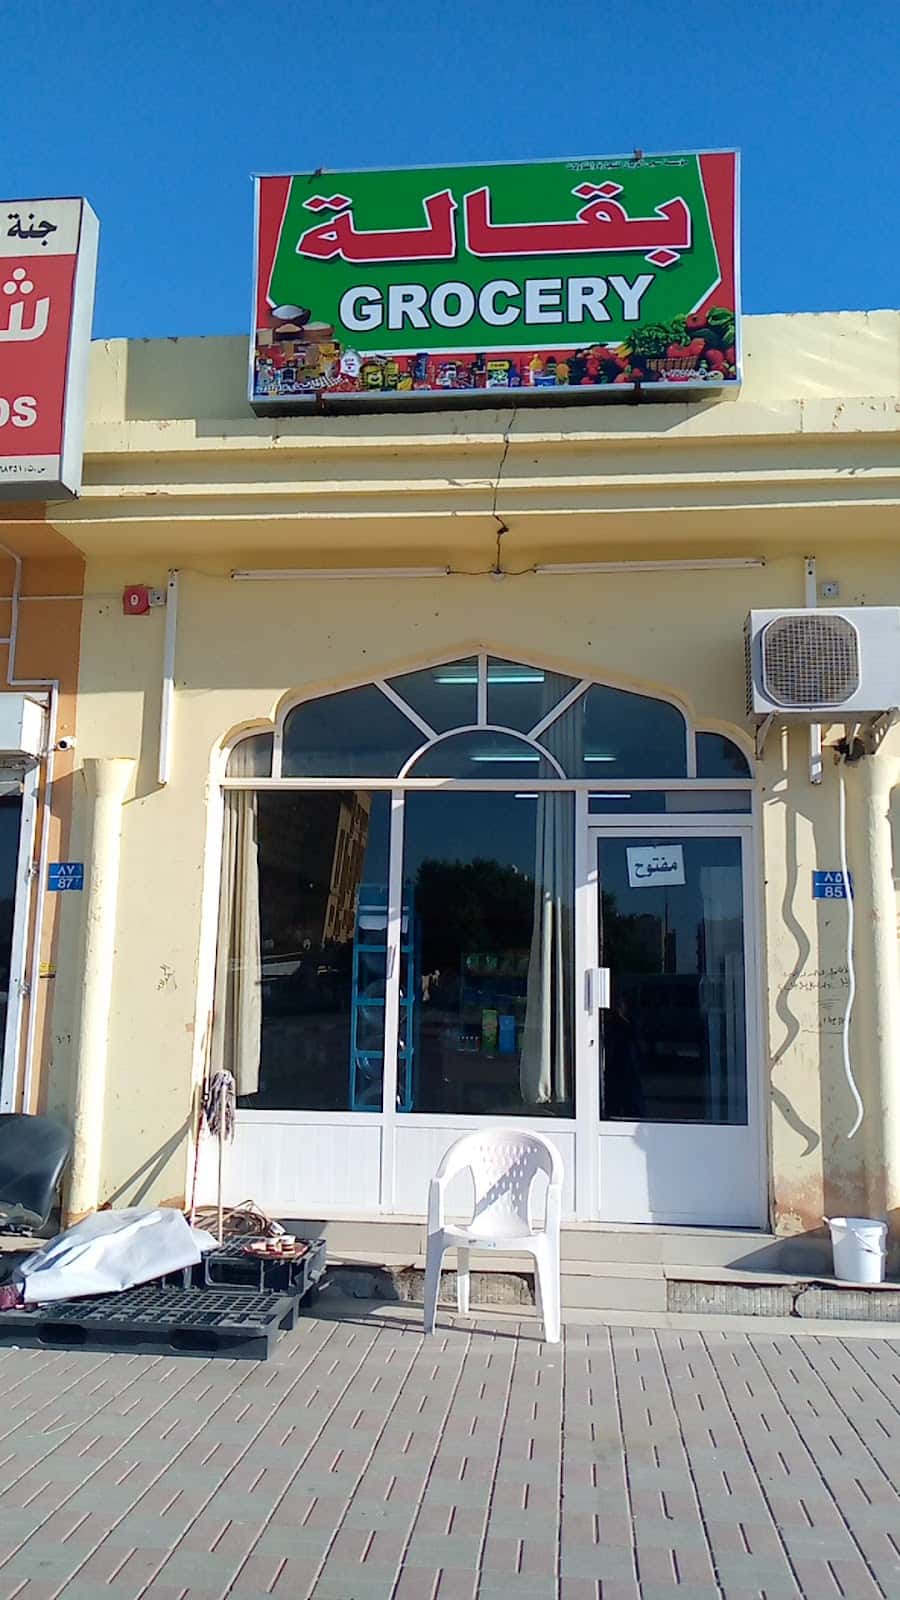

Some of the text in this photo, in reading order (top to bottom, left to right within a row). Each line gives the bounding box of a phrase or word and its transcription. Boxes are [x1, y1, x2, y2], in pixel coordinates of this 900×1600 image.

[7, 213, 58, 247] جنة
[297, 181, 692, 268] بقالة
[339, 274, 656, 332] GROCERY
[57, 864, 76, 876] ٨٧
[634, 856, 678, 879] مفتوح
[57, 877, 73, 889] 87
[824, 872, 843, 883] ٨٥
[824, 886, 844, 898] 85
